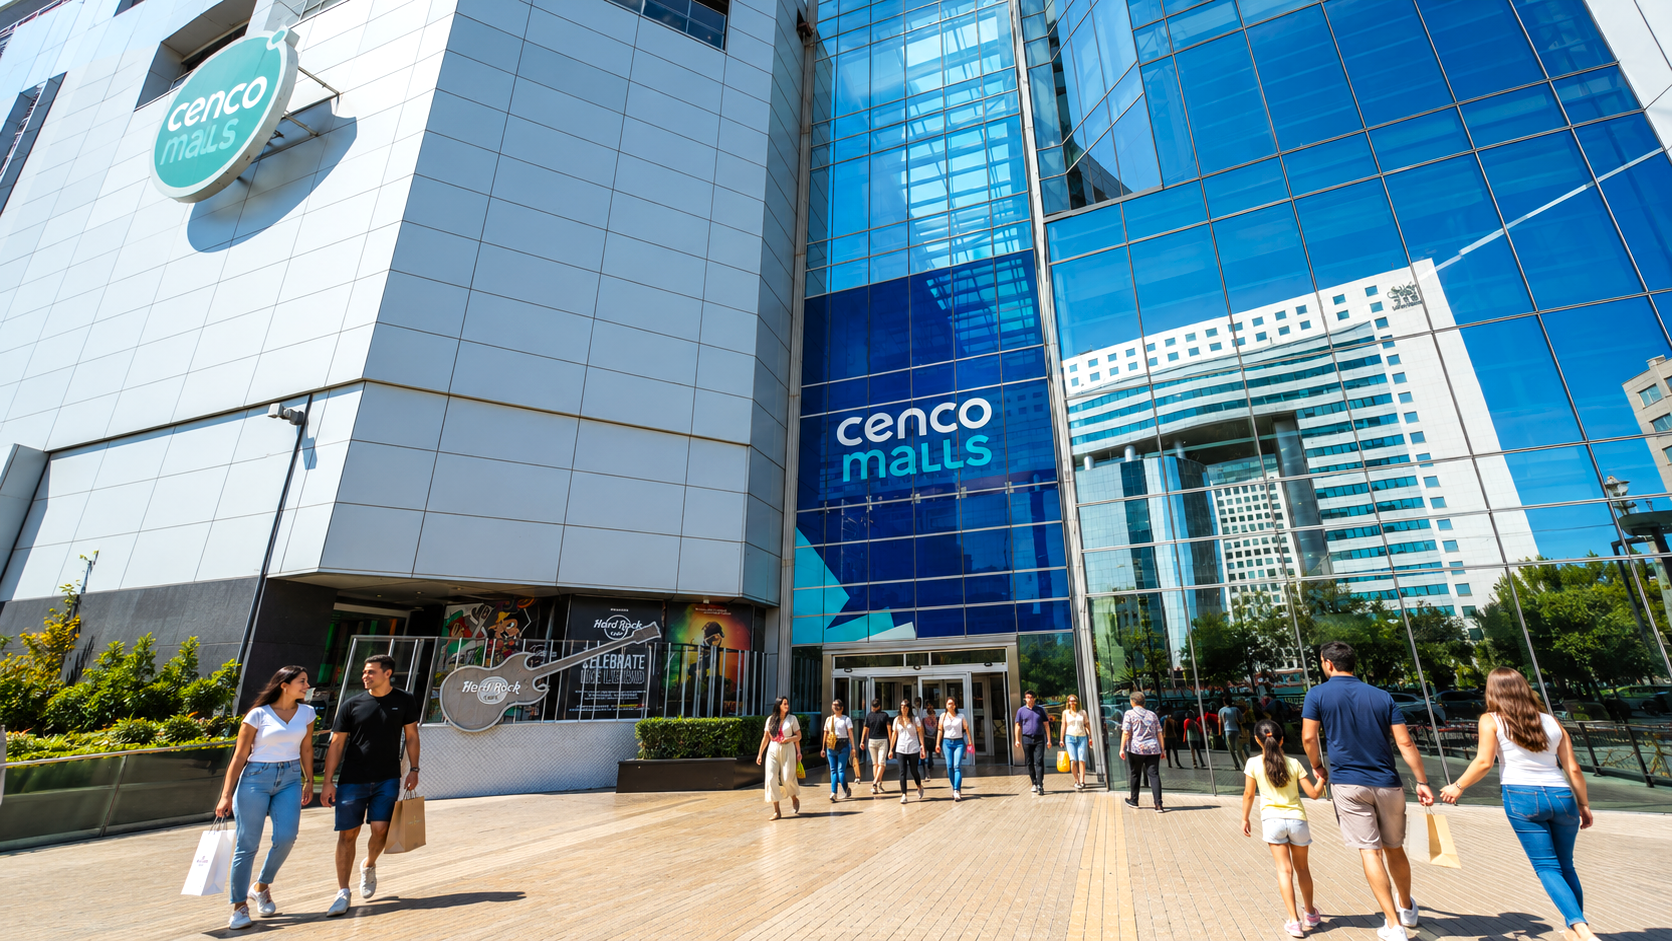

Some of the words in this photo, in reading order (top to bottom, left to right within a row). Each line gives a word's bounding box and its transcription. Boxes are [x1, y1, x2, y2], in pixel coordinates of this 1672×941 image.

[167, 76, 267, 132] cenco
[836, 397, 993, 447] cenco
[593, 619, 618, 629] Hard
[618, 620, 643, 632] Rock
[494, 681, 521, 695] Rock
